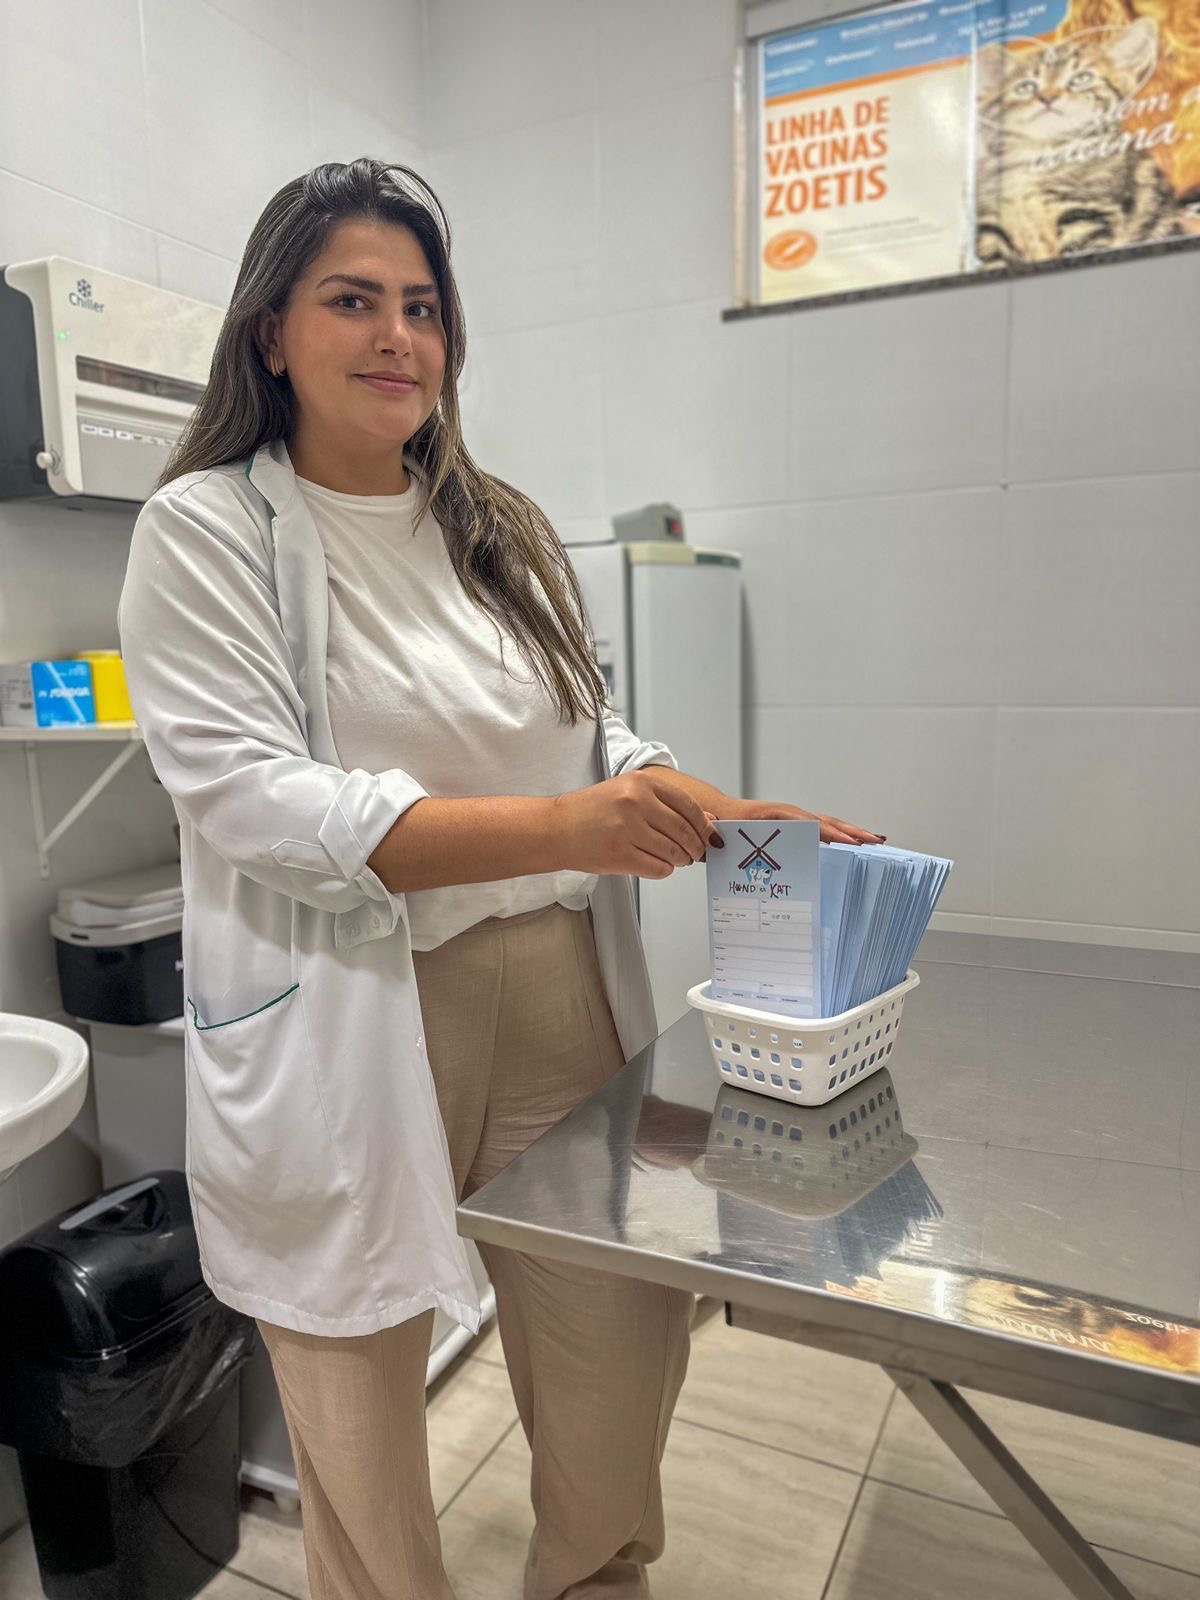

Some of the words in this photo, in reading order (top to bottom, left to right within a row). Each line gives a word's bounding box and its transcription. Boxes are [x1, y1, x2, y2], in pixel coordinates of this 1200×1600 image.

[766, 107, 845, 145] LINHA
[855, 96, 890, 127] DE
[765, 128, 889, 177] VACINAS
[765, 164, 888, 218] ZOETIS
[69, 292, 104, 313] Chiller
[770, 884, 791, 898] KAT
